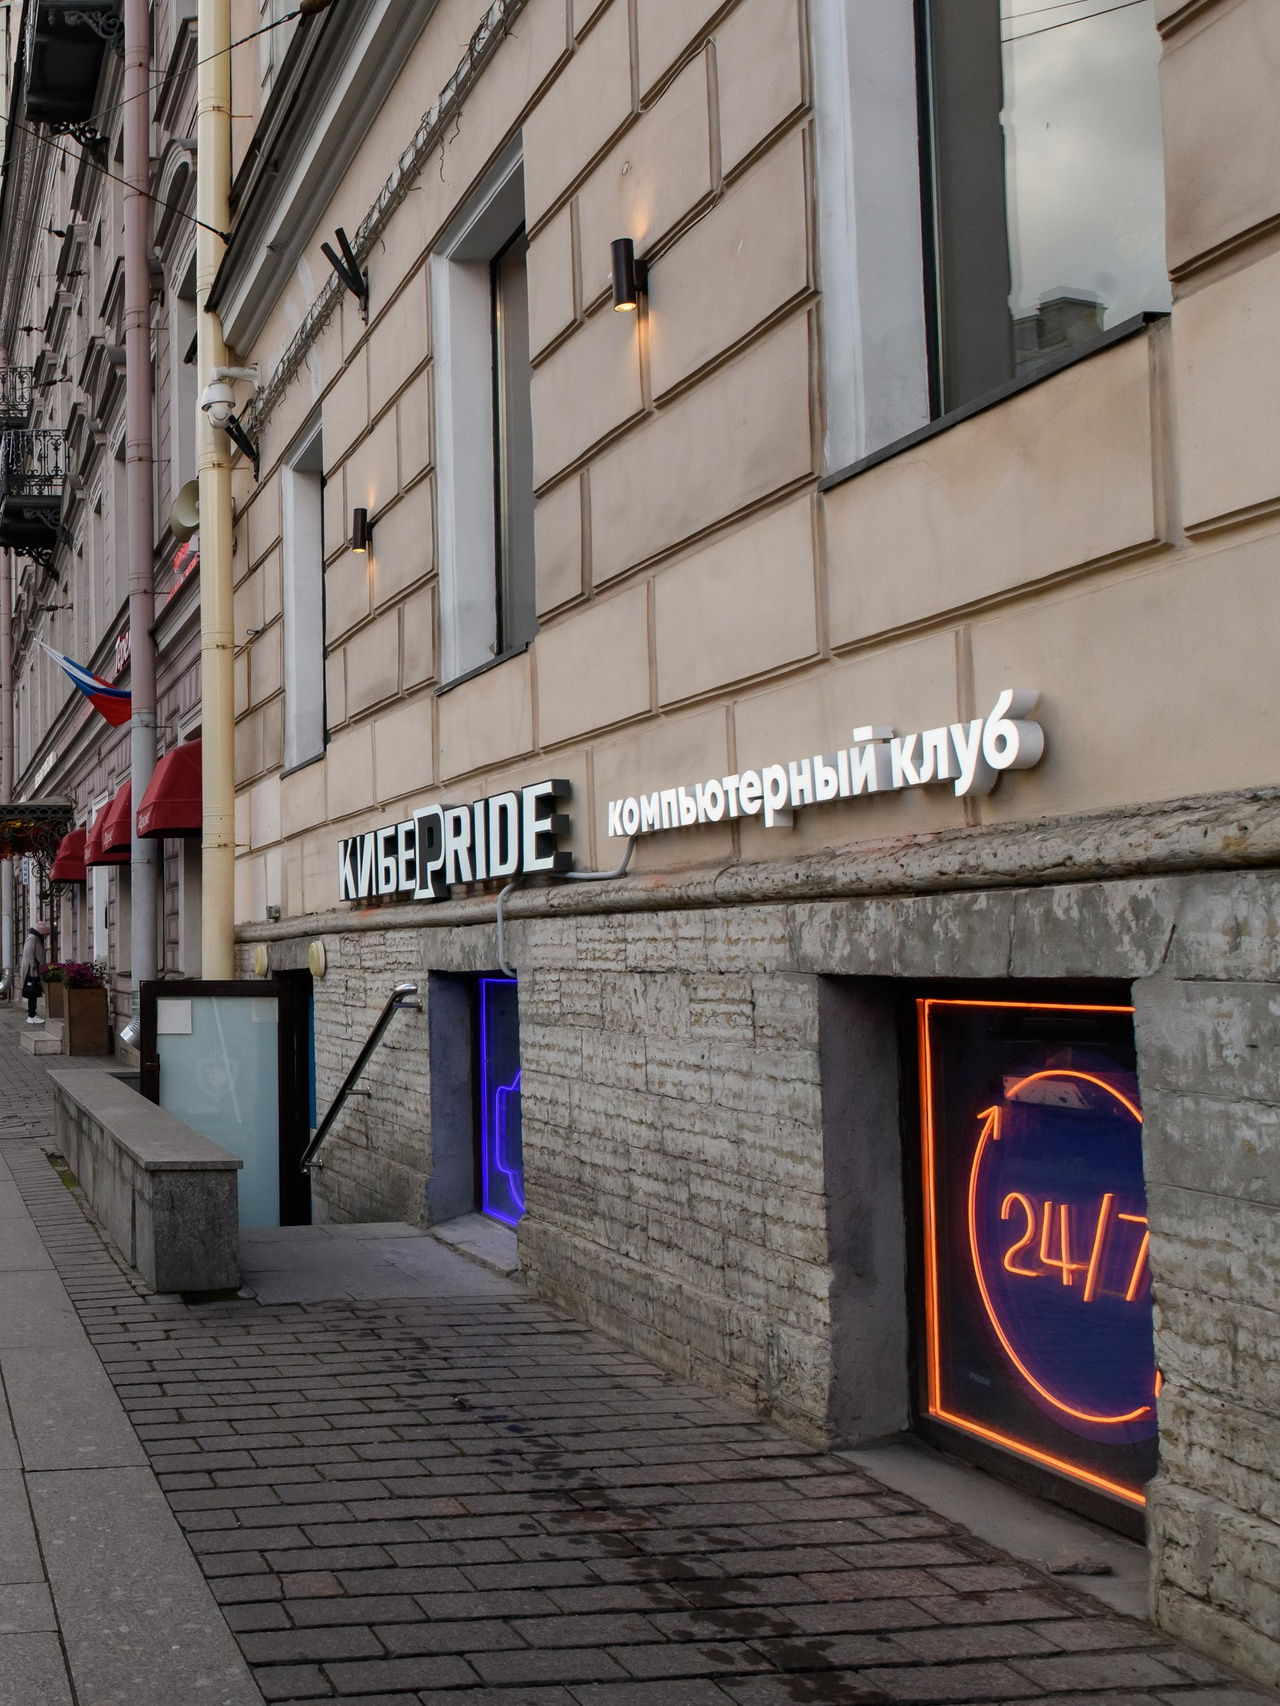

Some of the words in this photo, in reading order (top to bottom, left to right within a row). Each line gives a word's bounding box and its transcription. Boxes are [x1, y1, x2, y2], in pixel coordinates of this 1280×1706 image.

[608, 727, 884, 837] компьютерный
[890, 688, 1036, 796] клуб
[1000, 1191, 1151, 1303] 24/7
